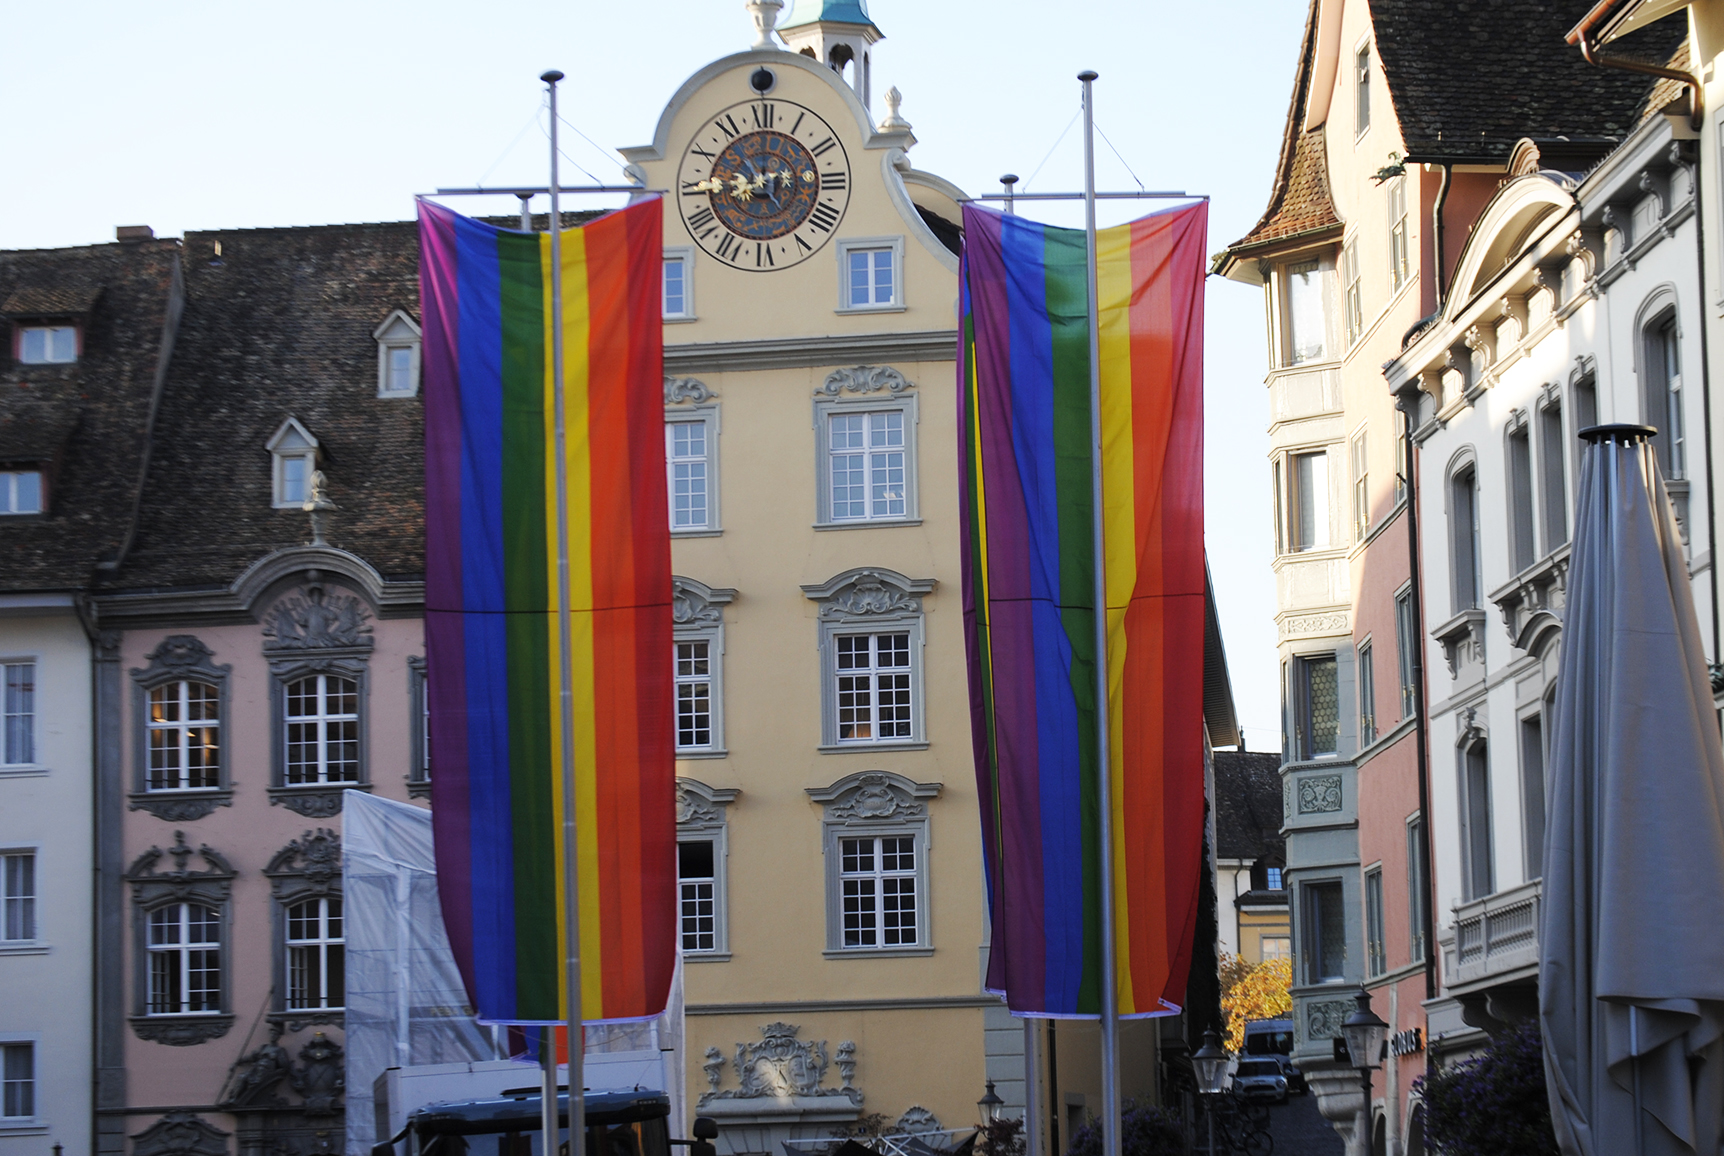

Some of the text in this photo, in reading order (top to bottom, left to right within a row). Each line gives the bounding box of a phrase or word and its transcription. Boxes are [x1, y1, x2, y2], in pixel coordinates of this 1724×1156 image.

[714, 113, 740, 143] XI
[750, 104, 774, 131] XII
[790, 112, 805, 135] I
[691, 142, 716, 164] X
[811, 136, 837, 158] II
[821, 172, 846, 190] III
[687, 207, 721, 241] VIII
[808, 201, 840, 233] IIII
[715, 231, 744, 263] VII
[756, 242, 775, 268] VI
[794, 233, 813, 257] V
